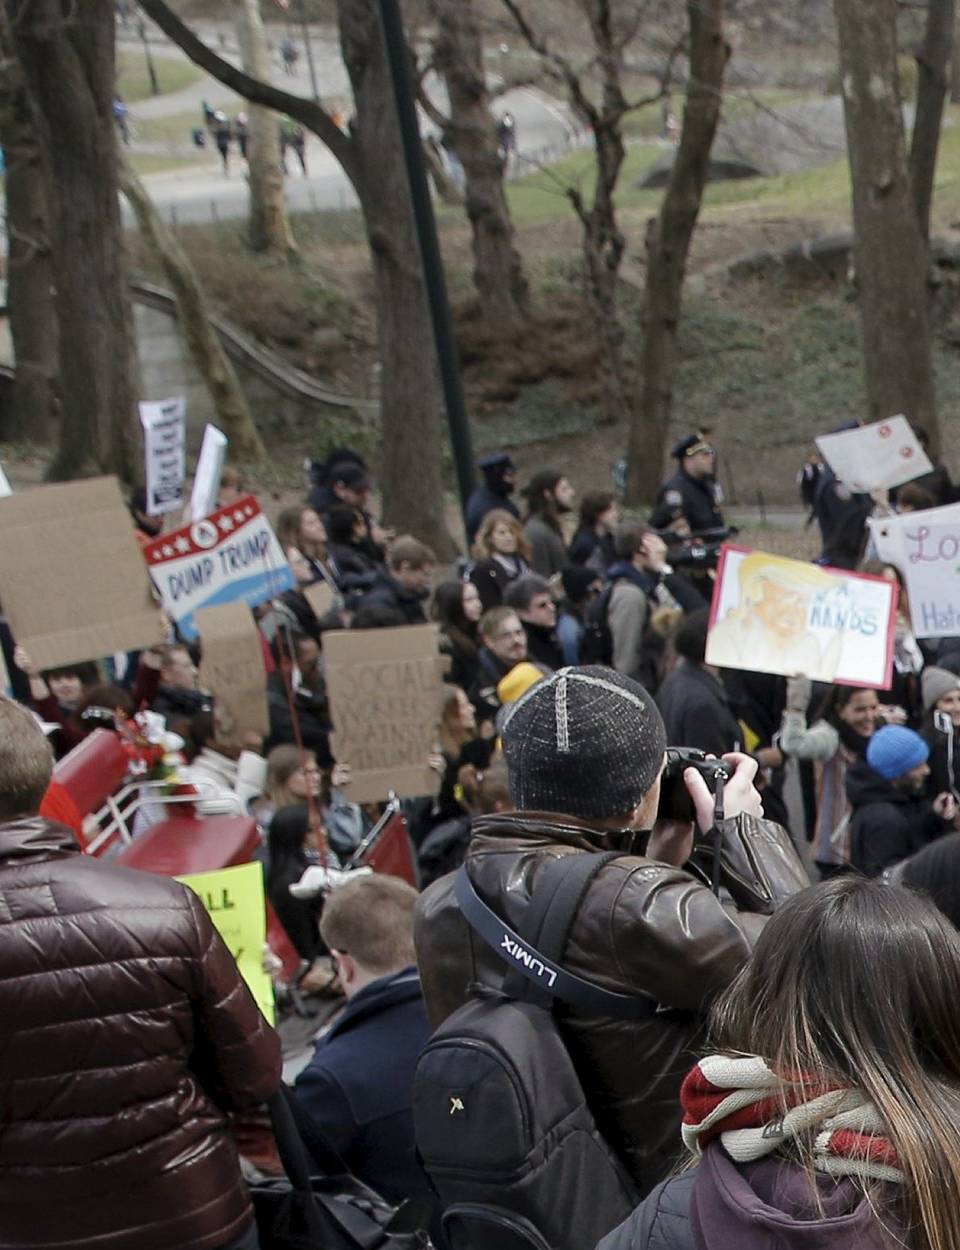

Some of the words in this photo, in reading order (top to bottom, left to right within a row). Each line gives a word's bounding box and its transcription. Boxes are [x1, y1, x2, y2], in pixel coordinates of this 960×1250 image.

[168, 558, 214, 600] DUMP
[218, 530, 270, 576] TRUMP
[501, 934, 557, 987] LUMIX
